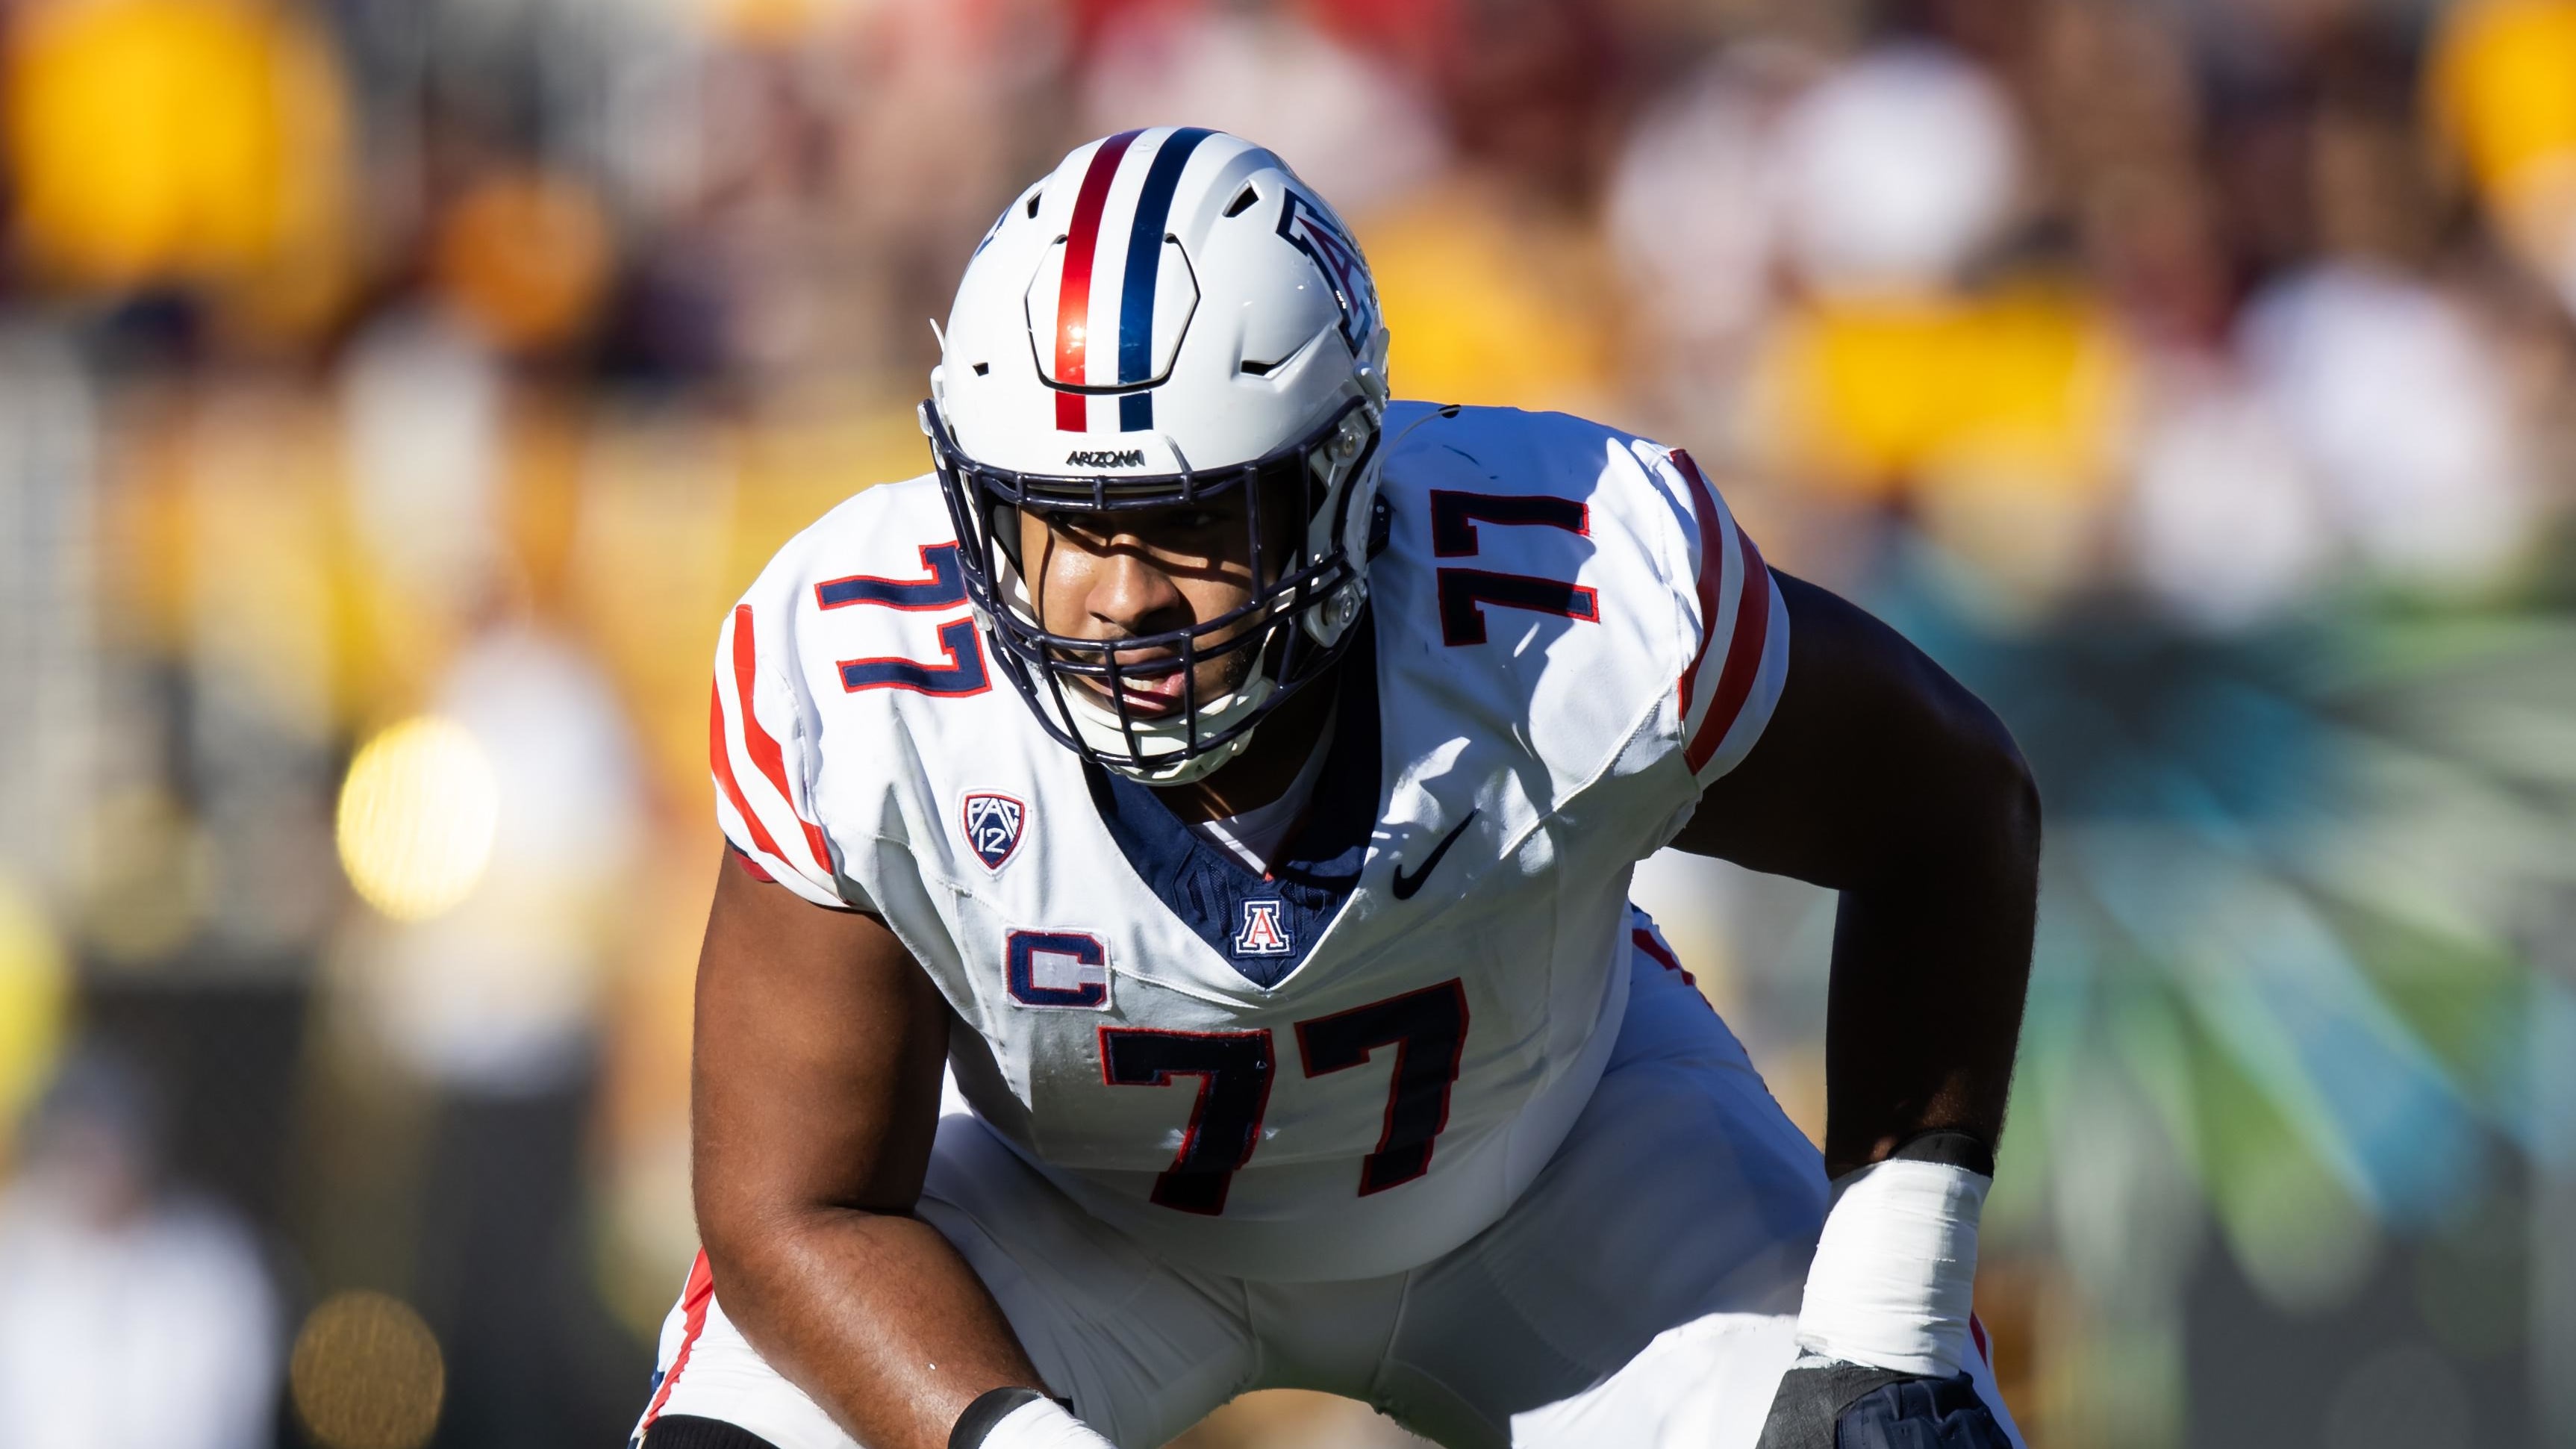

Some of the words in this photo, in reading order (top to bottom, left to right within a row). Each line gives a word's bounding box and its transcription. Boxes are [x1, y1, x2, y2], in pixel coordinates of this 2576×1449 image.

[1276, 187, 1373, 359] A
[1066, 449, 1146, 468] ARIZONA
[1429, 489, 1600, 646] 77
[814, 540, 993, 698] 77
[967, 797, 1020, 842] PAC
[978, 827, 1006, 854] 12
[1235, 900, 1290, 954] A
[1006, 930, 1107, 1007] C
[1098, 977, 1471, 1217] 77
